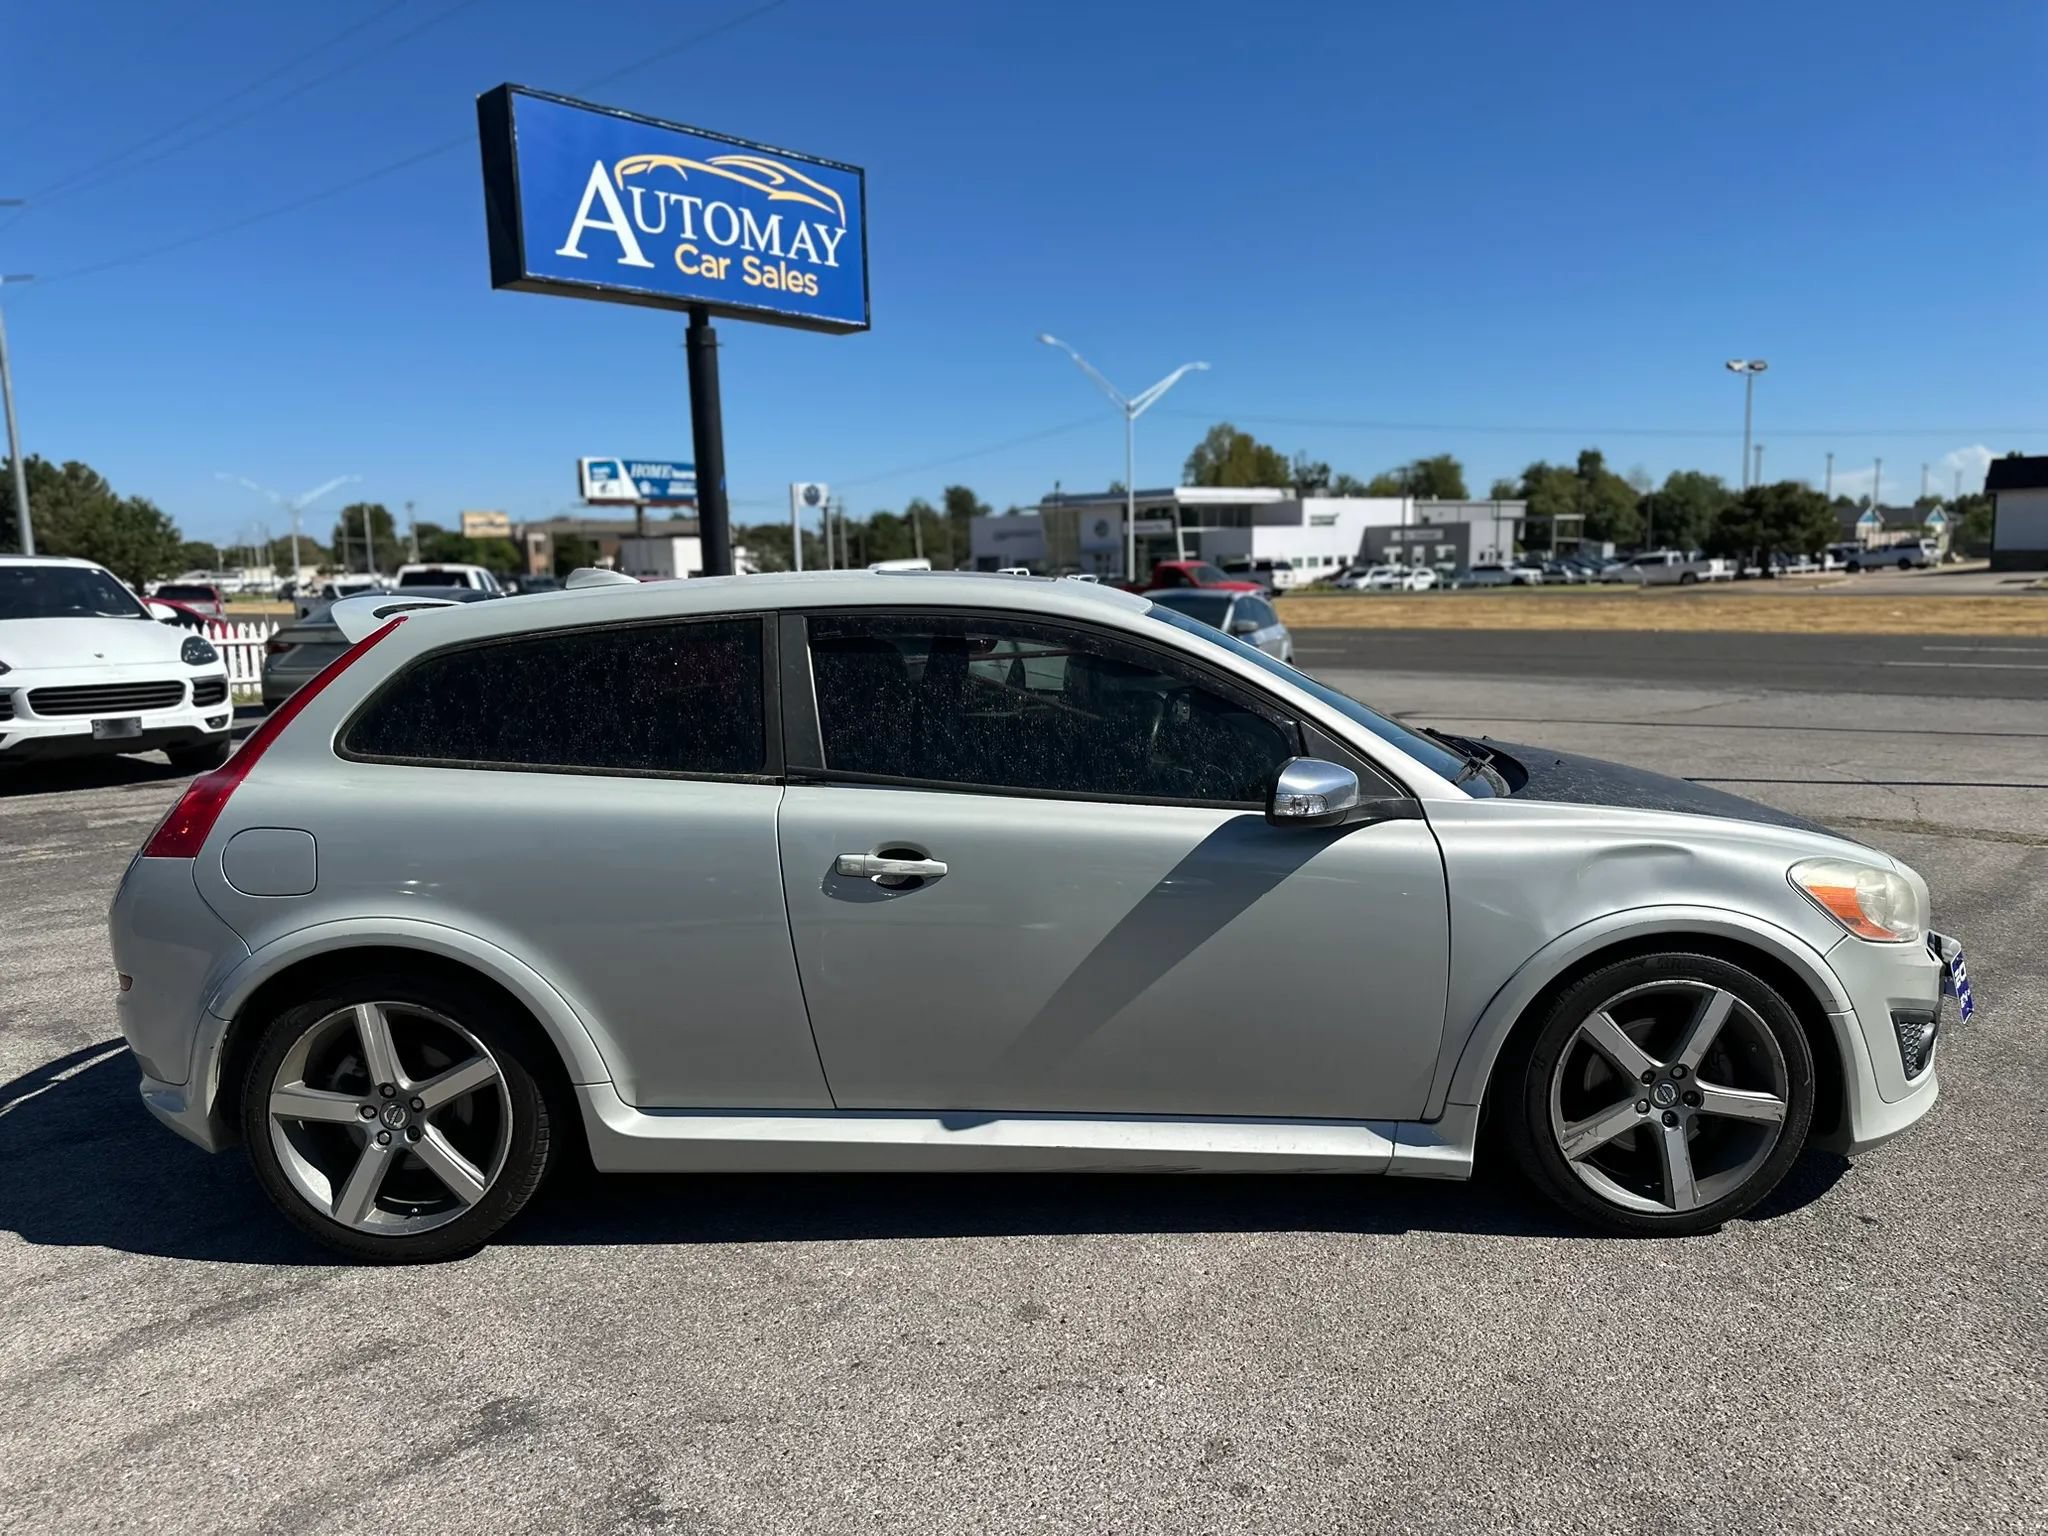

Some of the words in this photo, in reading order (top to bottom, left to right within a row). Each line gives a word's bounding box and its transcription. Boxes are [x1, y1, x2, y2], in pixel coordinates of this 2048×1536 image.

[555, 160, 847, 268] AUTOMAY
[674, 243, 731, 281] Car
[742, 255, 819, 297] Sales
[630, 463, 672, 479] HOME
